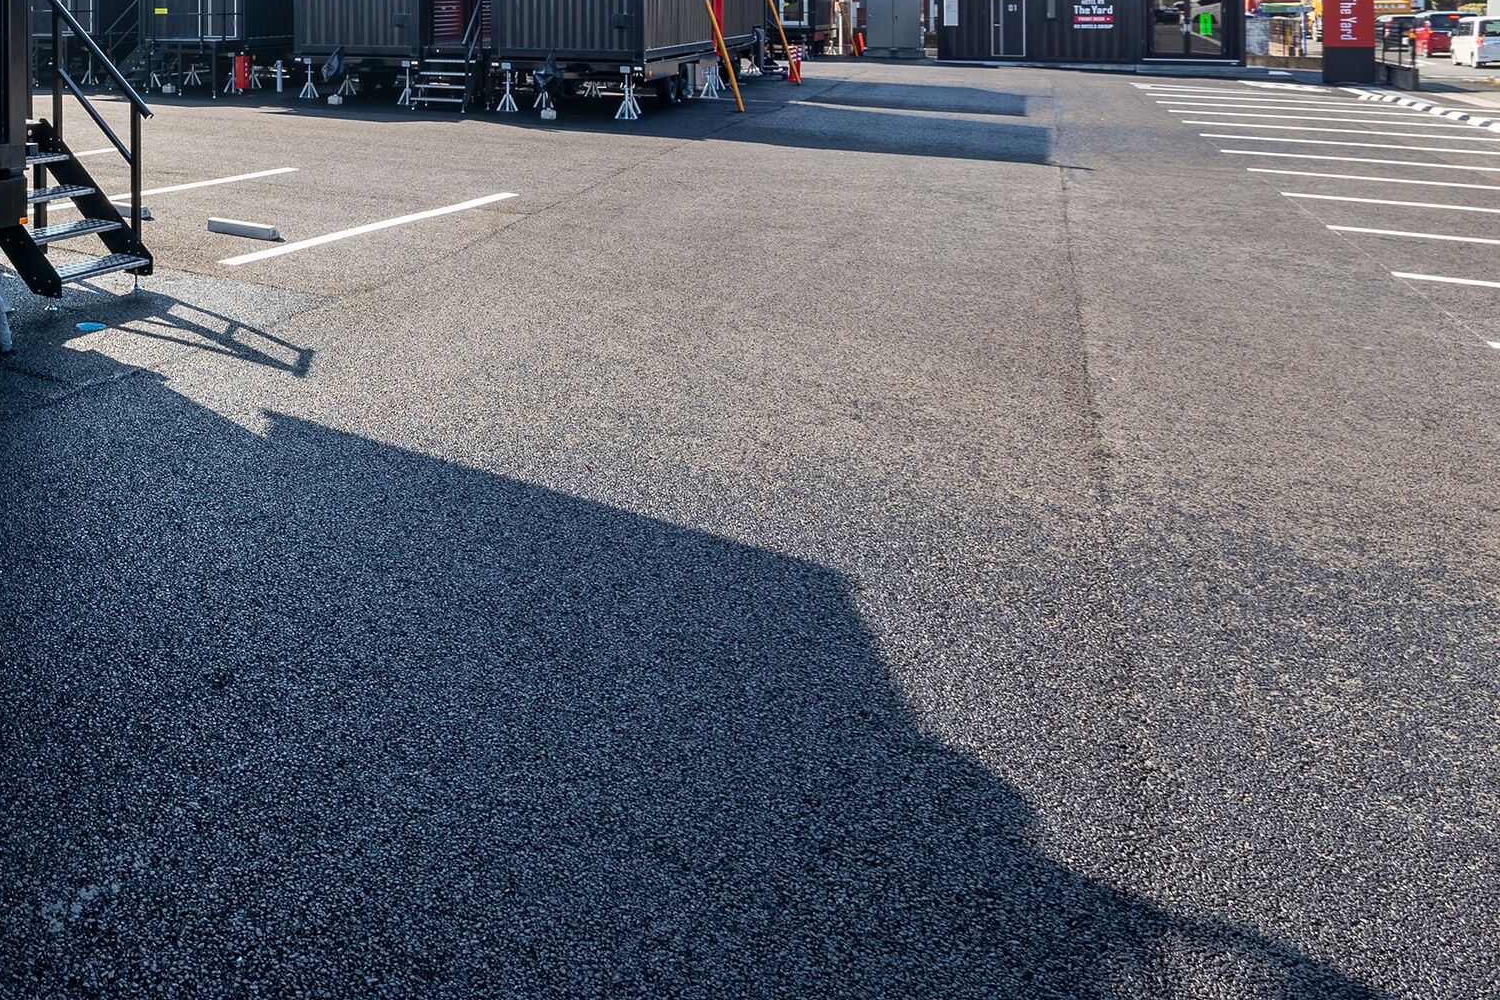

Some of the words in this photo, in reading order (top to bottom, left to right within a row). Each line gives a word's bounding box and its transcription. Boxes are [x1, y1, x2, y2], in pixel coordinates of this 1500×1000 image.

[1073, 5, 1091, 14] The
[1091, 5, 1113, 14] Yard
[1340, 16, 1357, 40] Yard
